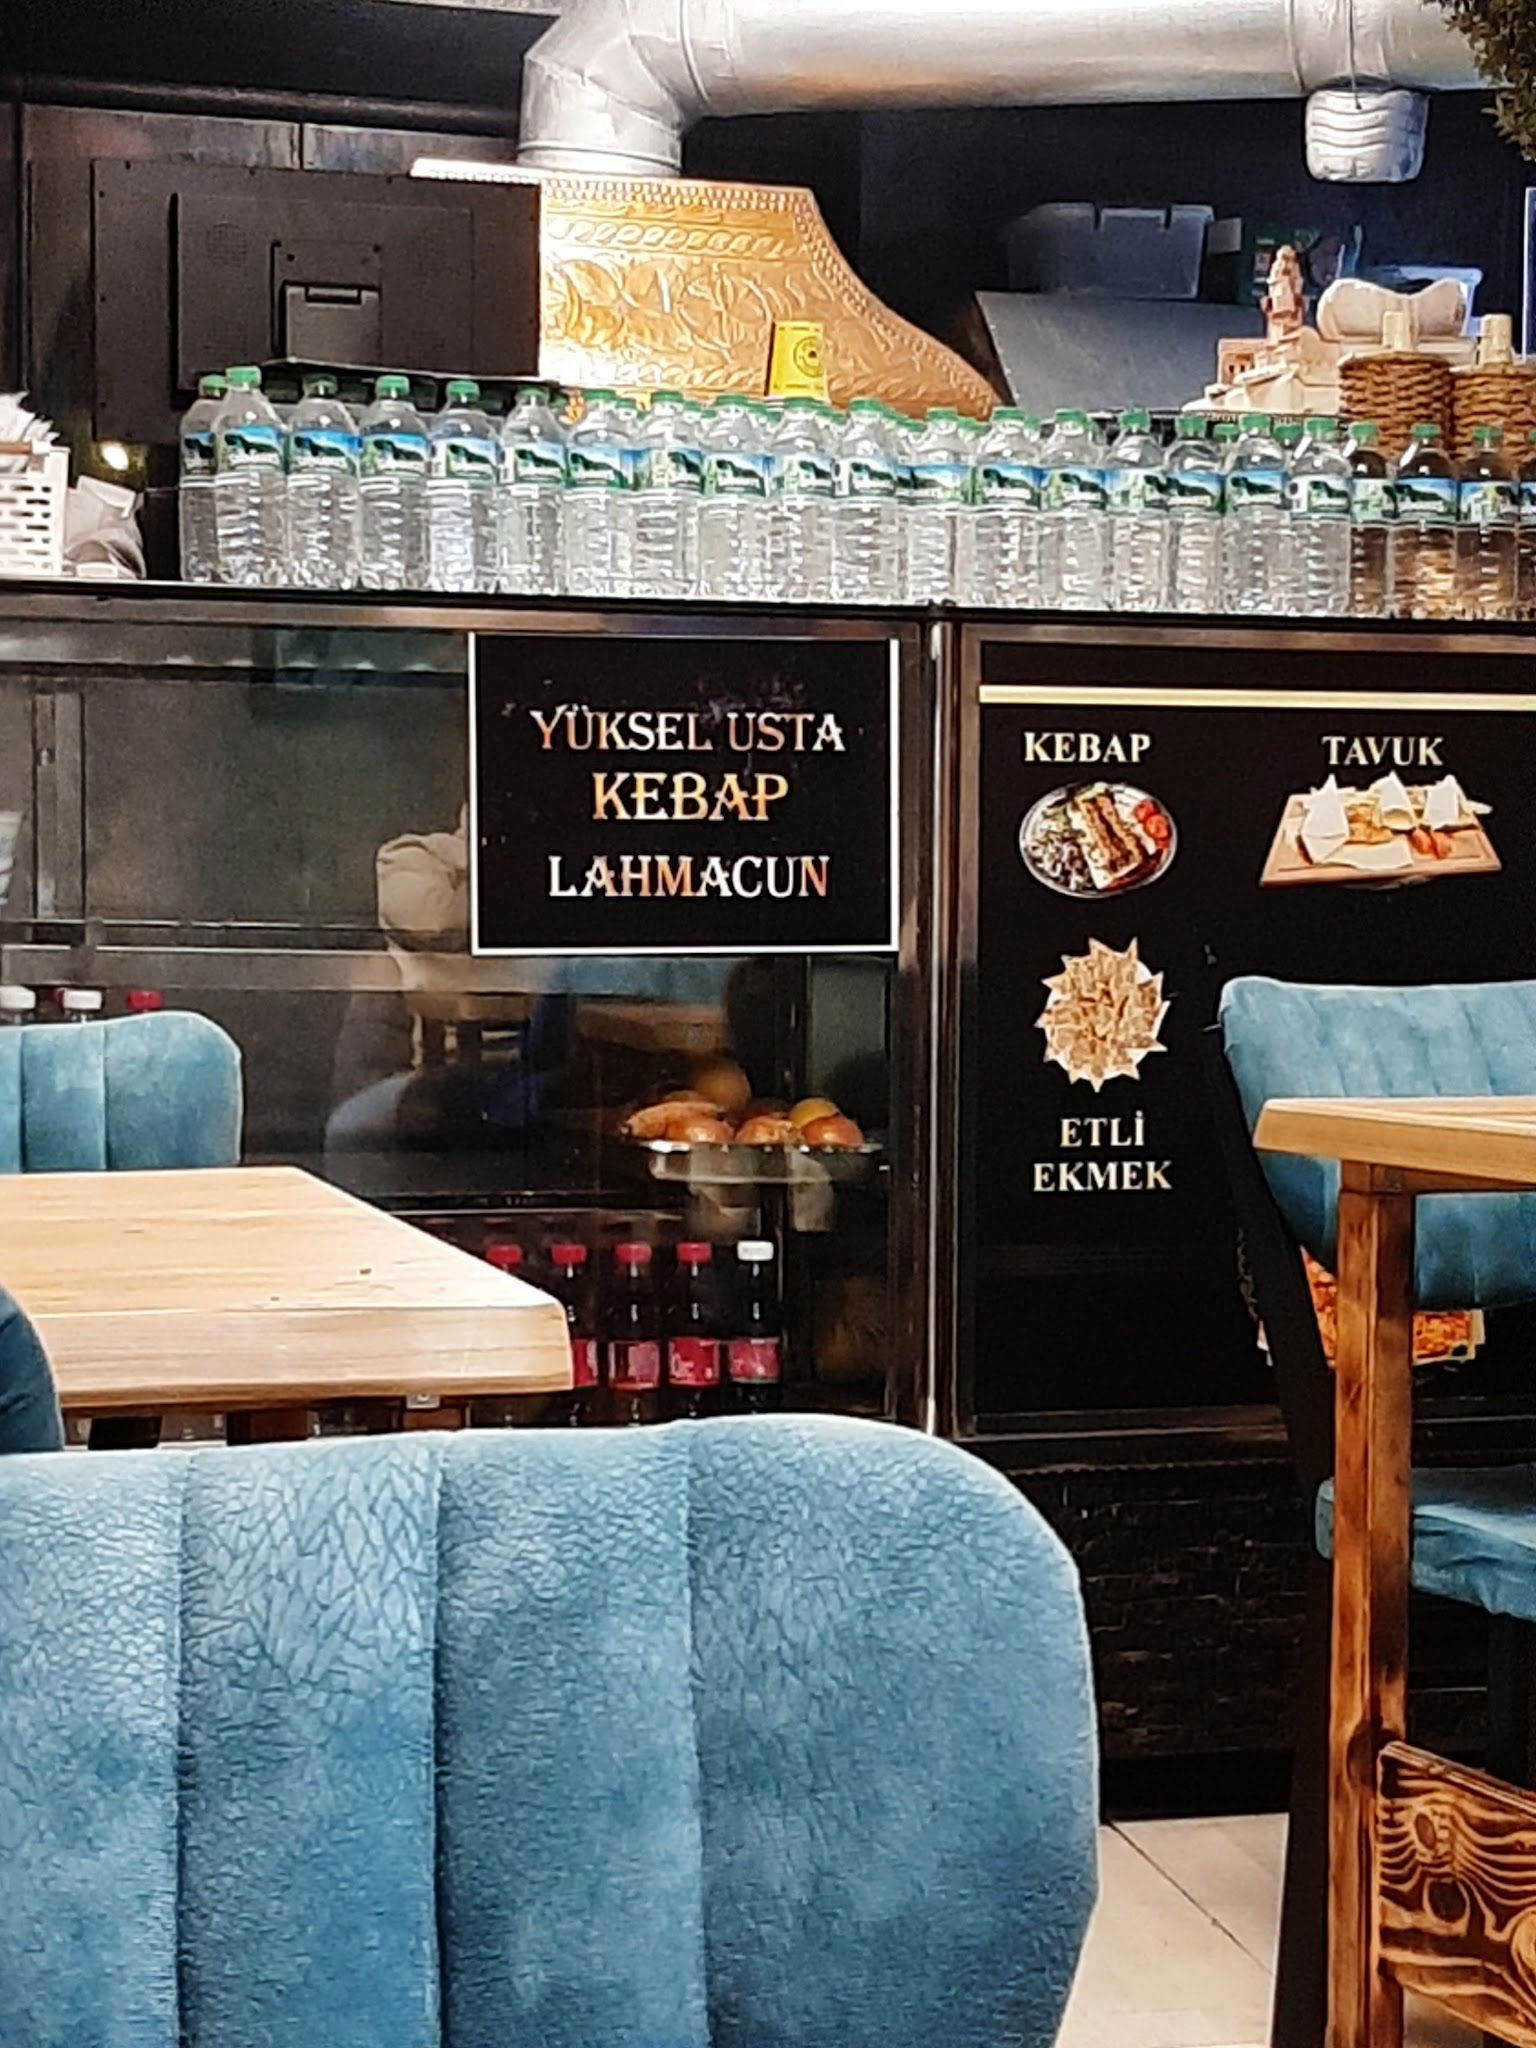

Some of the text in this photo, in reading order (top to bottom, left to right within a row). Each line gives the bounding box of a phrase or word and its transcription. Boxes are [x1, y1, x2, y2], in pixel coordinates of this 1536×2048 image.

[530, 704, 846, 751] YÜKSEL USTA
[1024, 731, 1151, 762] KEBAP
[1322, 736, 1444, 765] TAVUK
[592, 772, 789, 820] KEBAP
[548, 855, 830, 897] LAHMACUN
[1060, 1110, 1145, 1146] ETLİ
[1033, 1161, 1172, 1192] EKMEK
